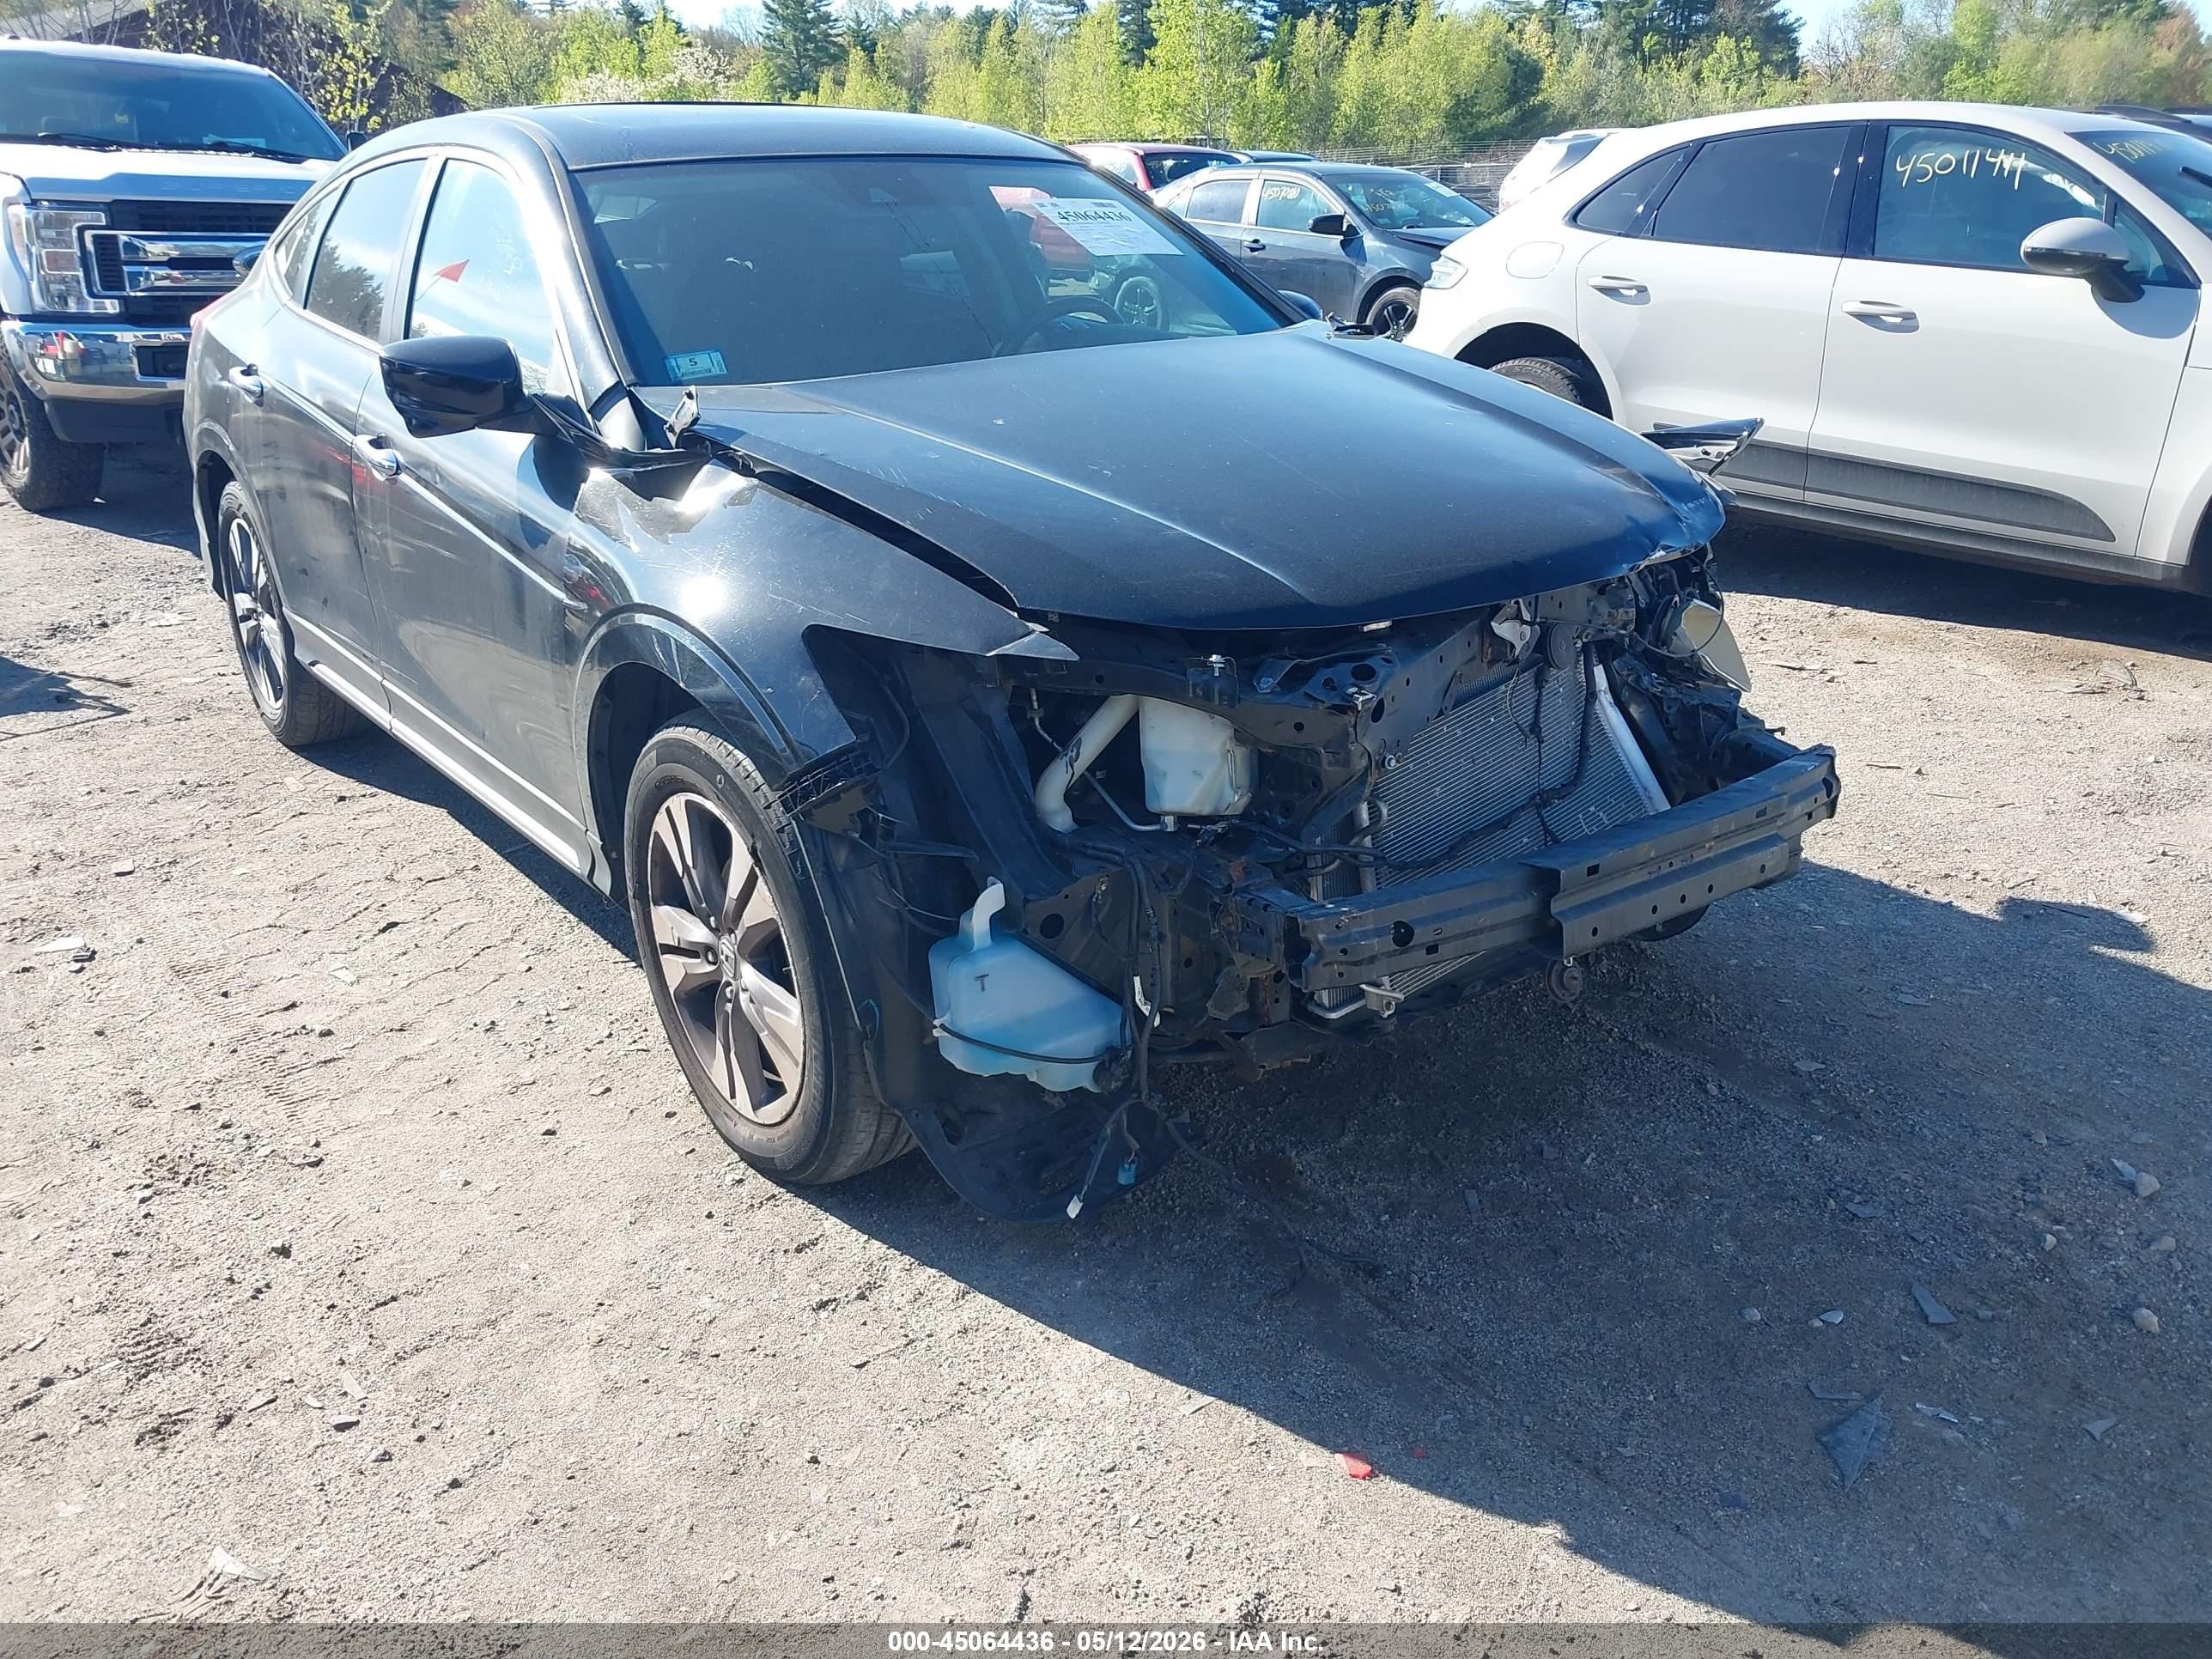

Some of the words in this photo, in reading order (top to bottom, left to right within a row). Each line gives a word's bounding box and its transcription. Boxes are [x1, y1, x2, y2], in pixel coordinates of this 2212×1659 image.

[1057, 210, 1133, 222] 45064436
[689, 357, 698, 367] 5
[974, 973, 990, 993] T
